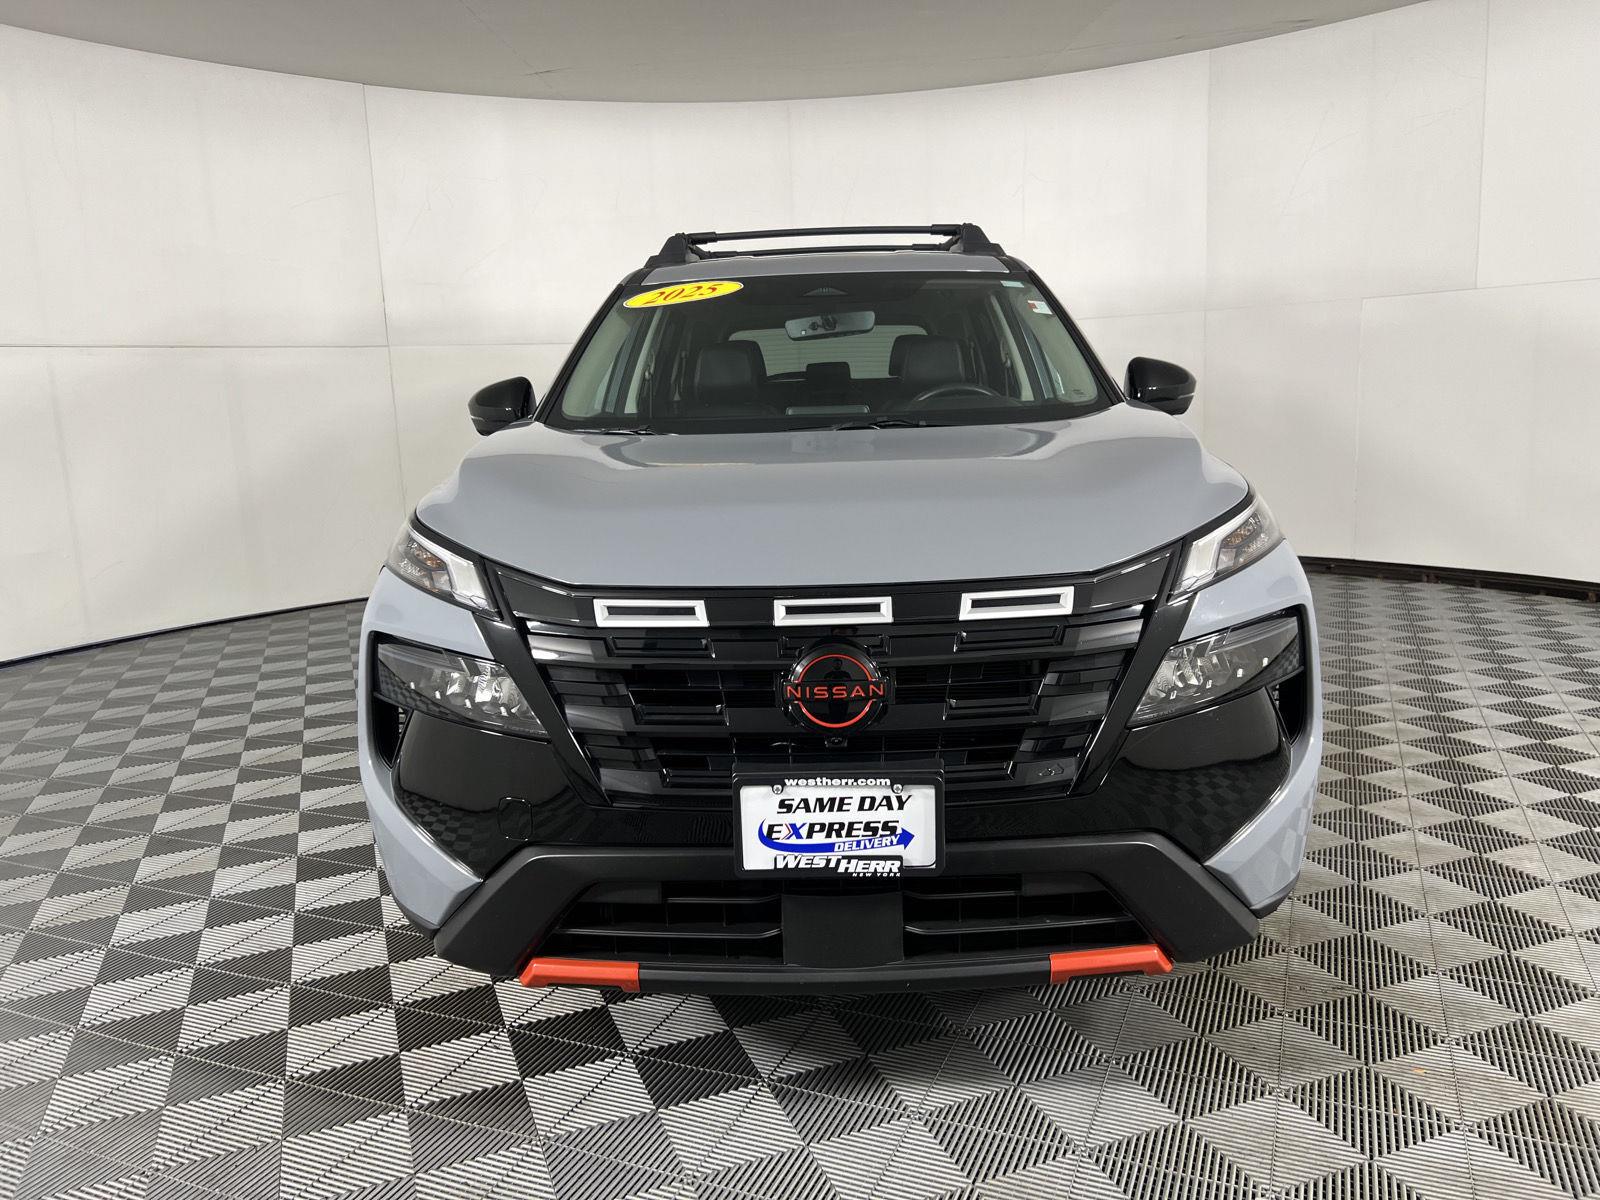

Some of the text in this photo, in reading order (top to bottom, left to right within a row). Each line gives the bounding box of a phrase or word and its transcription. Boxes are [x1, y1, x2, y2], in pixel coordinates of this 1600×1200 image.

[641, 283, 723, 305] 2025
[786, 683, 884, 699] NISSAN
[784, 777, 890, 786] westherr.com
[777, 795, 912, 814] SAME DAY
[766, 820, 900, 841] EXPRESS
[833, 834, 901, 852] DELIVERY
